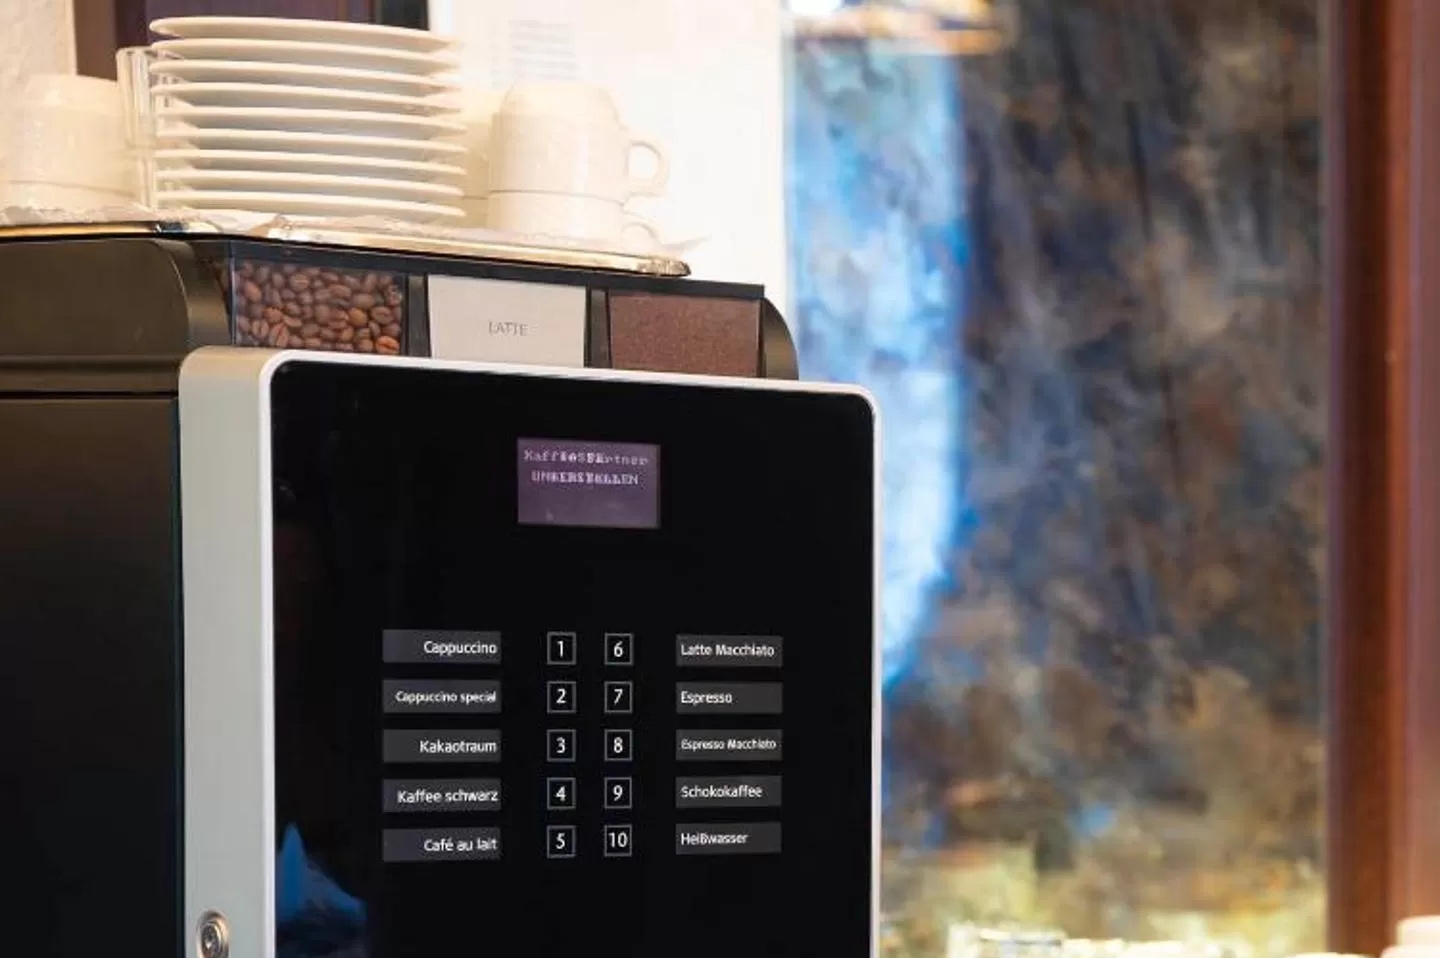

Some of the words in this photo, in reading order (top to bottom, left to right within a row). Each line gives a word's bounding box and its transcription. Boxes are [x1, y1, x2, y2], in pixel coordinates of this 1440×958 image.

[487, 320, 529, 337] LATTE
[423, 640, 498, 657] Cappuccino
[557, 640, 564, 657] 1
[613, 641, 624, 658] 6
[680, 644, 713, 656] Latte
[715, 643, 775, 657] Macchiato
[395, 690, 458, 705] Cappuccino
[460, 690, 497, 705] special
[556, 688, 566, 704] 2
[614, 688, 623, 704] 7
[680, 690, 733, 706] Espresso
[419, 739, 498, 754] Kakaotraum
[556, 737, 566, 754] 3
[613, 736, 623, 754] 8
[680, 738, 725, 752] Espresso
[727, 738, 777, 750] Macchiato
[397, 788, 442, 803] Kaffee
[444, 788, 499, 802] schwarz
[555, 786, 566, 801] 4
[613, 784, 623, 801] 9
[680, 784, 764, 798] Schokokaffee
[423, 837, 454, 852] Café
[456, 840, 474, 852] au
[476, 837, 498, 851] lait
[556, 832, 566, 850] 5
[609, 831, 628, 848] 10
[680, 832, 749, 846] Heißwasser
